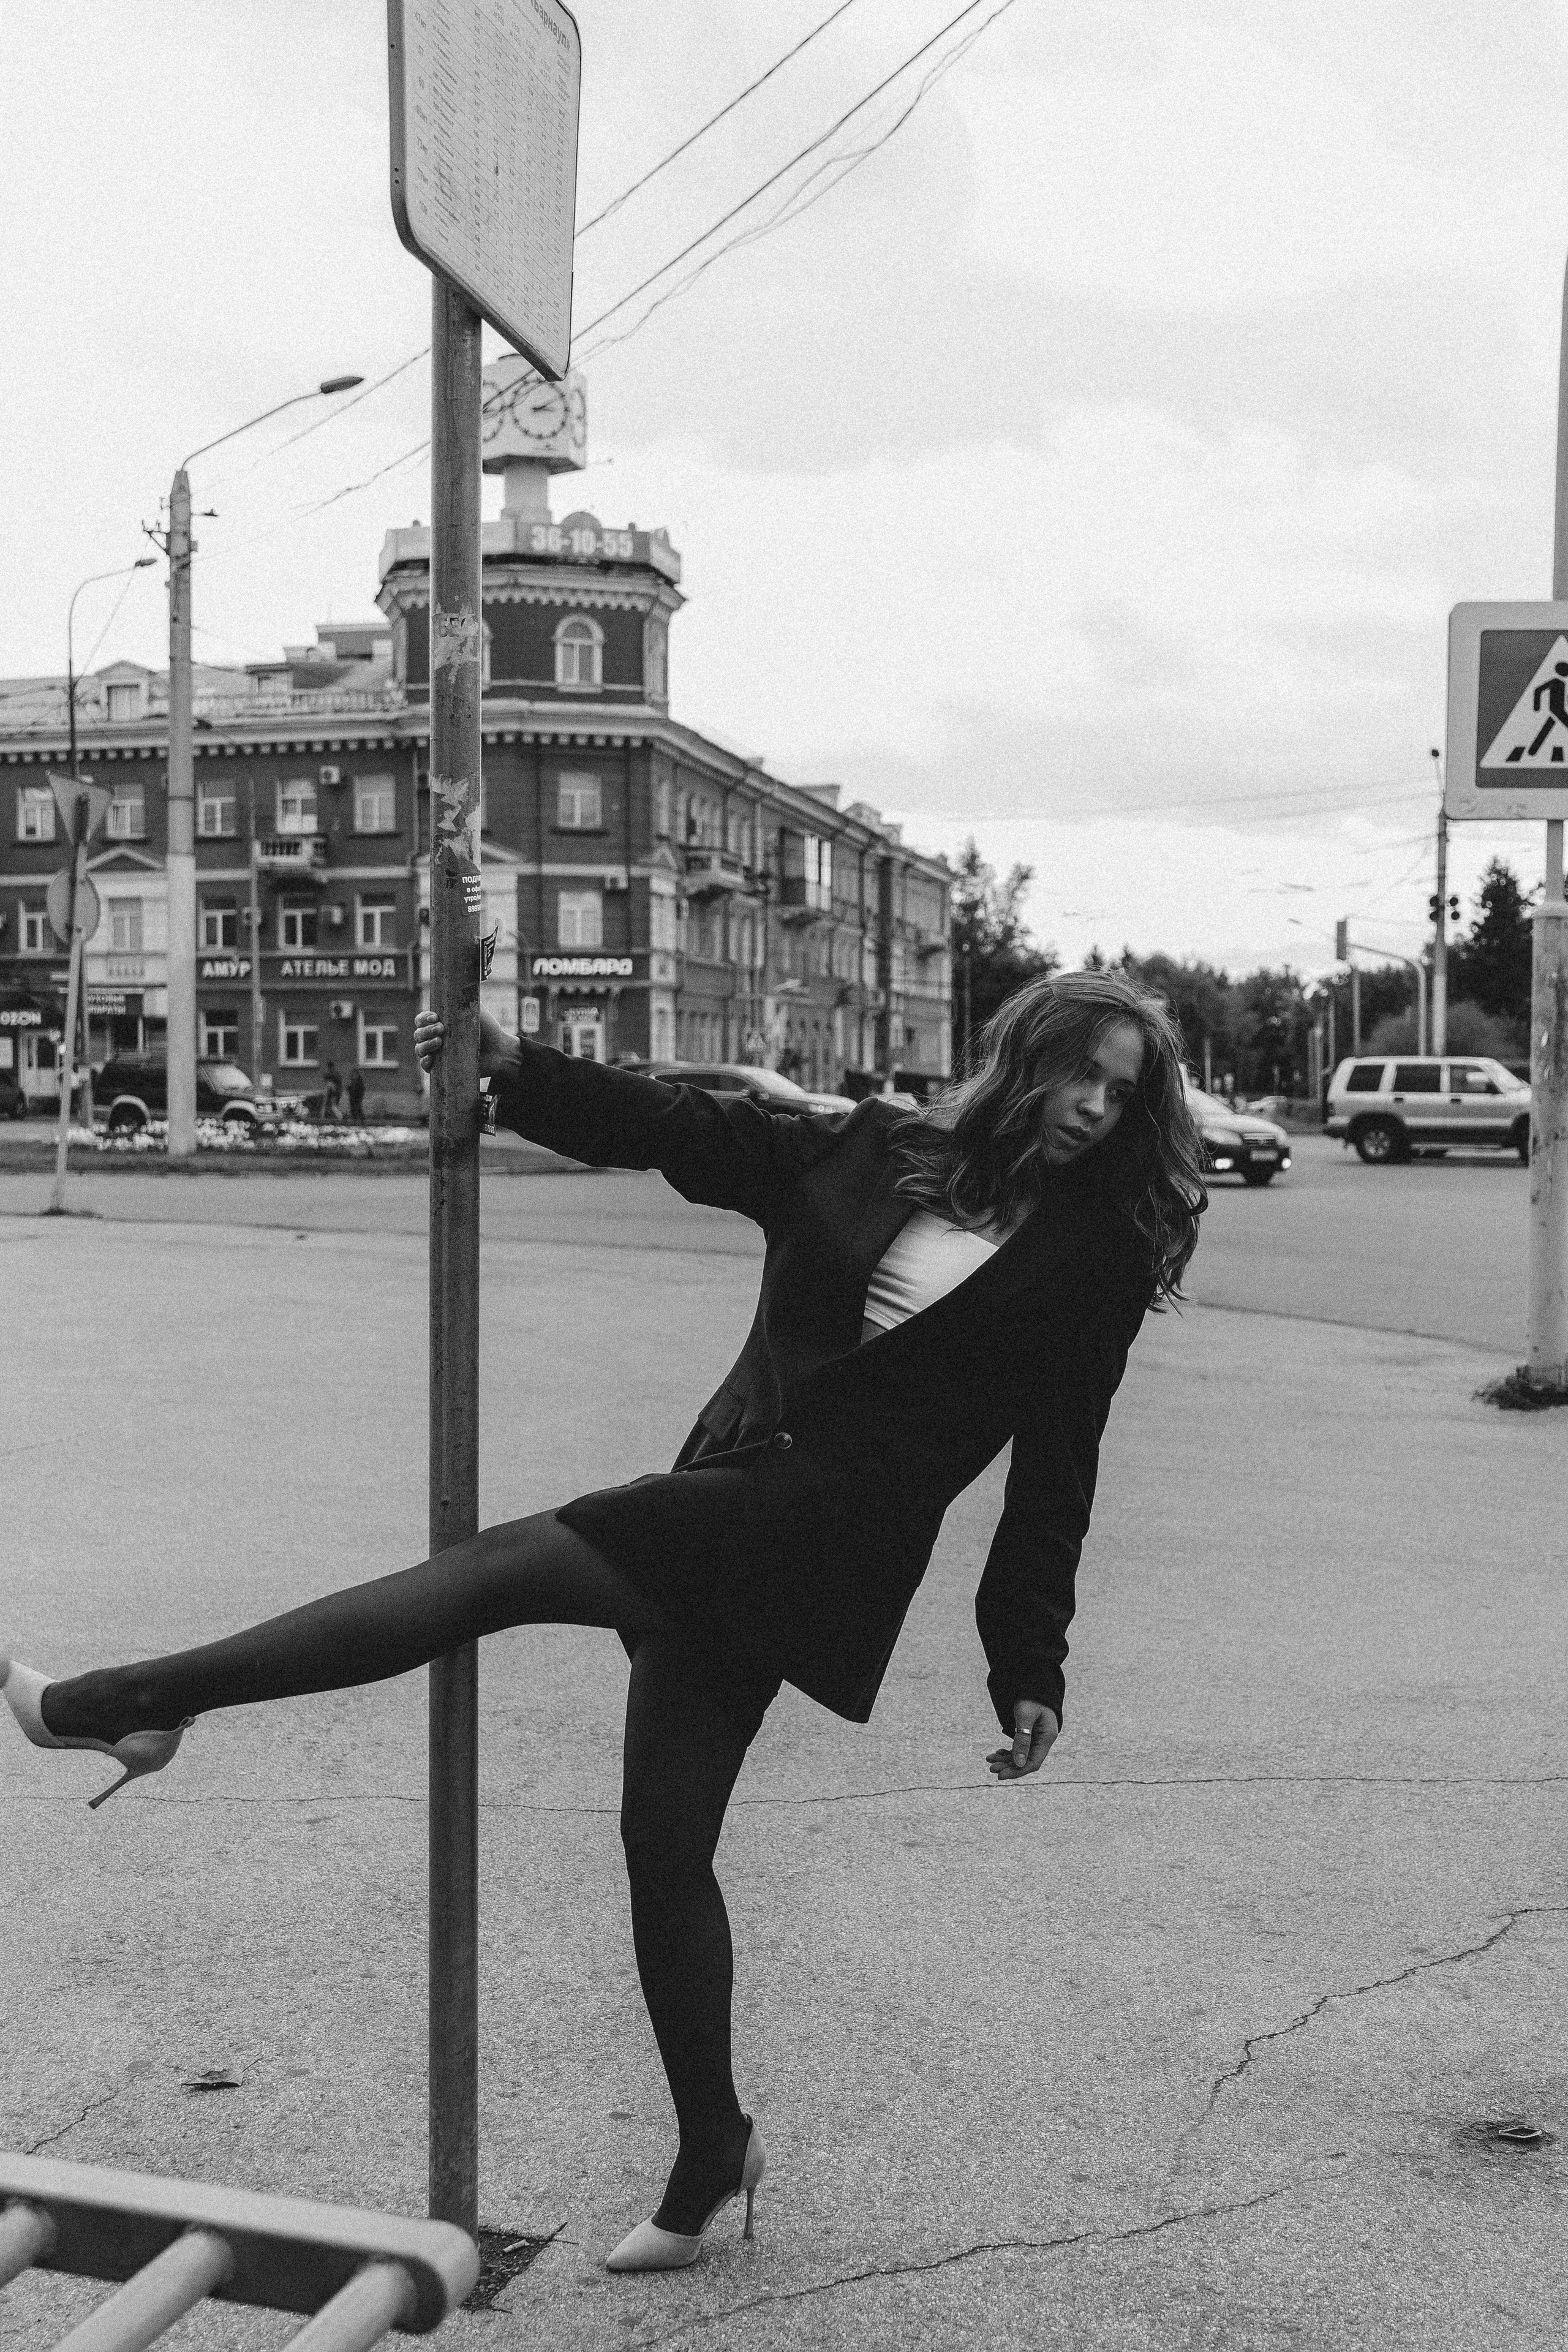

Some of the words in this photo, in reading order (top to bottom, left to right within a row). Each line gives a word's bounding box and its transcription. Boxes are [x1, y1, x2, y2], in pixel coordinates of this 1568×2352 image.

[530, 525, 634, 558] 36-10-55
[202, 959, 251, 978] АМУР
[281, 959, 350, 977] АТЕЛЬЕ
[353, 959, 396, 977] МОД
[532, 957, 633, 975] ЛОМБАРД
